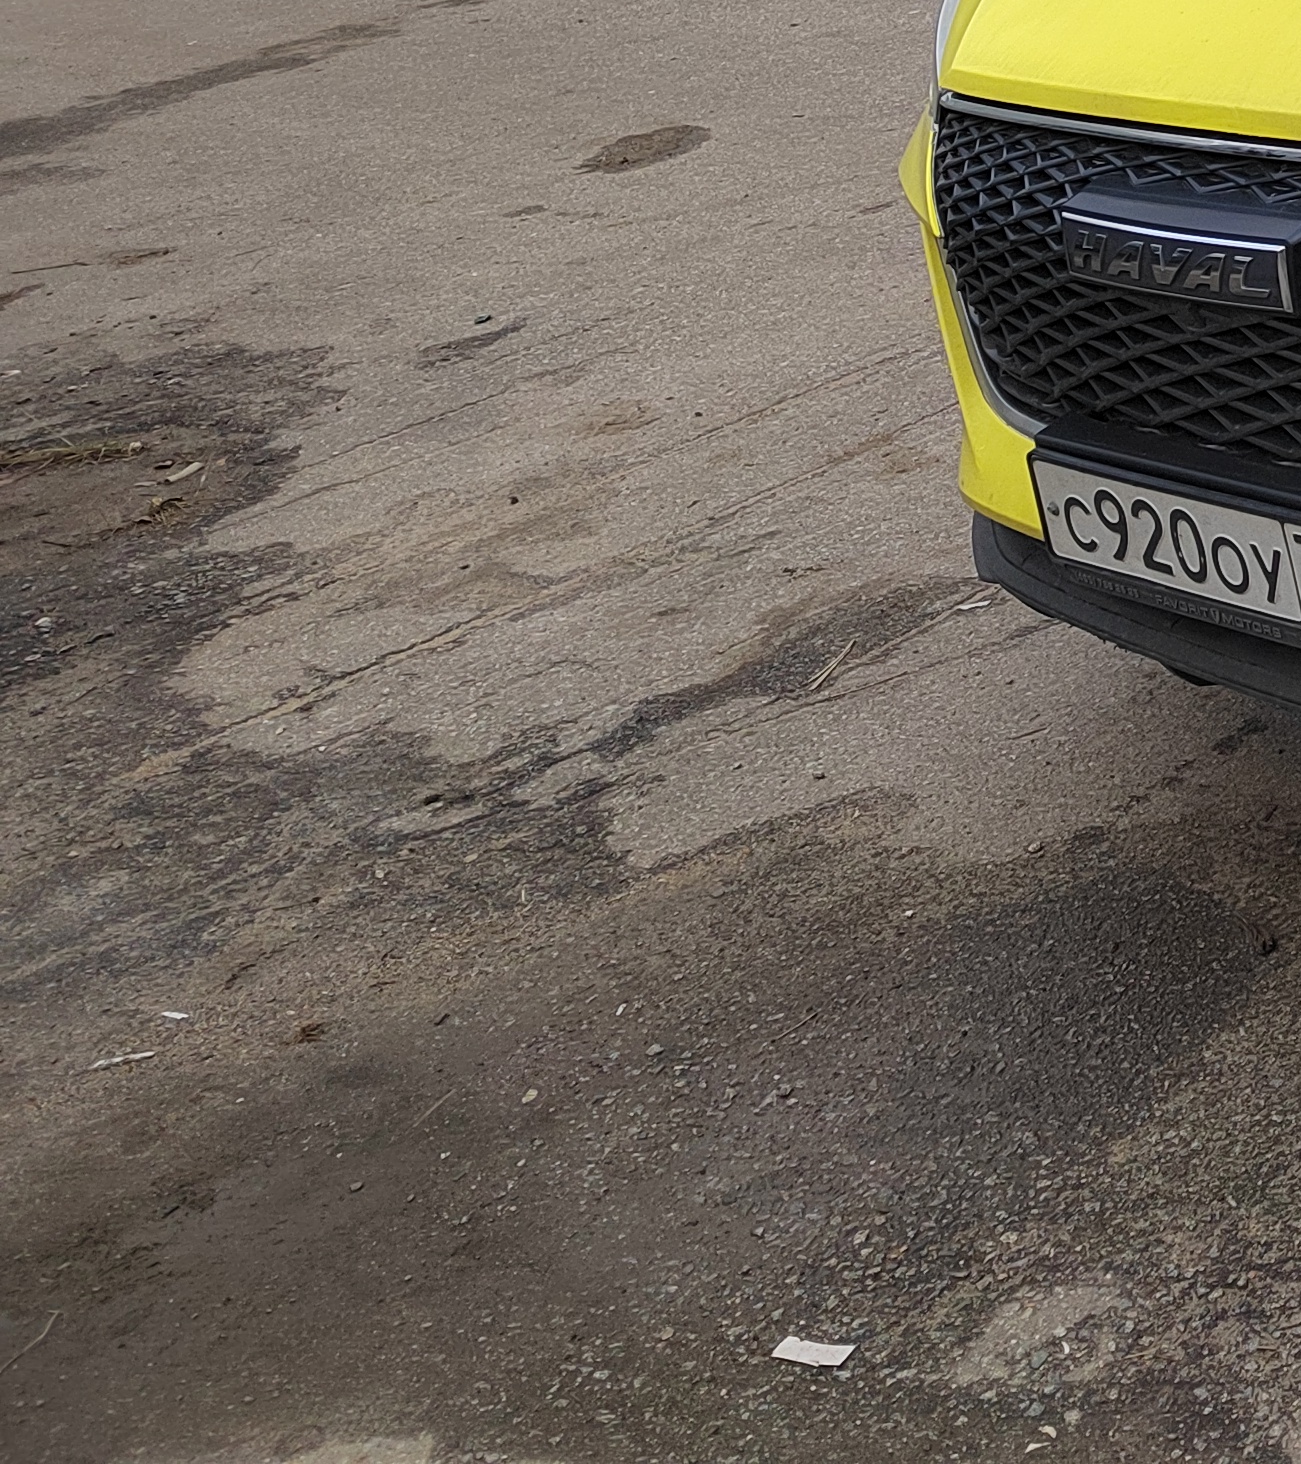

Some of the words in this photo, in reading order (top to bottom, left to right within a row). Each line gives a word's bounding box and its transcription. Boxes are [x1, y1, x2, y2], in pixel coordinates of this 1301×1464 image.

[1072, 229, 1271, 299] HAVAL
[1154, 593, 1210, 618] FAVORIT
[1220, 613, 1283, 638] MOTORS
